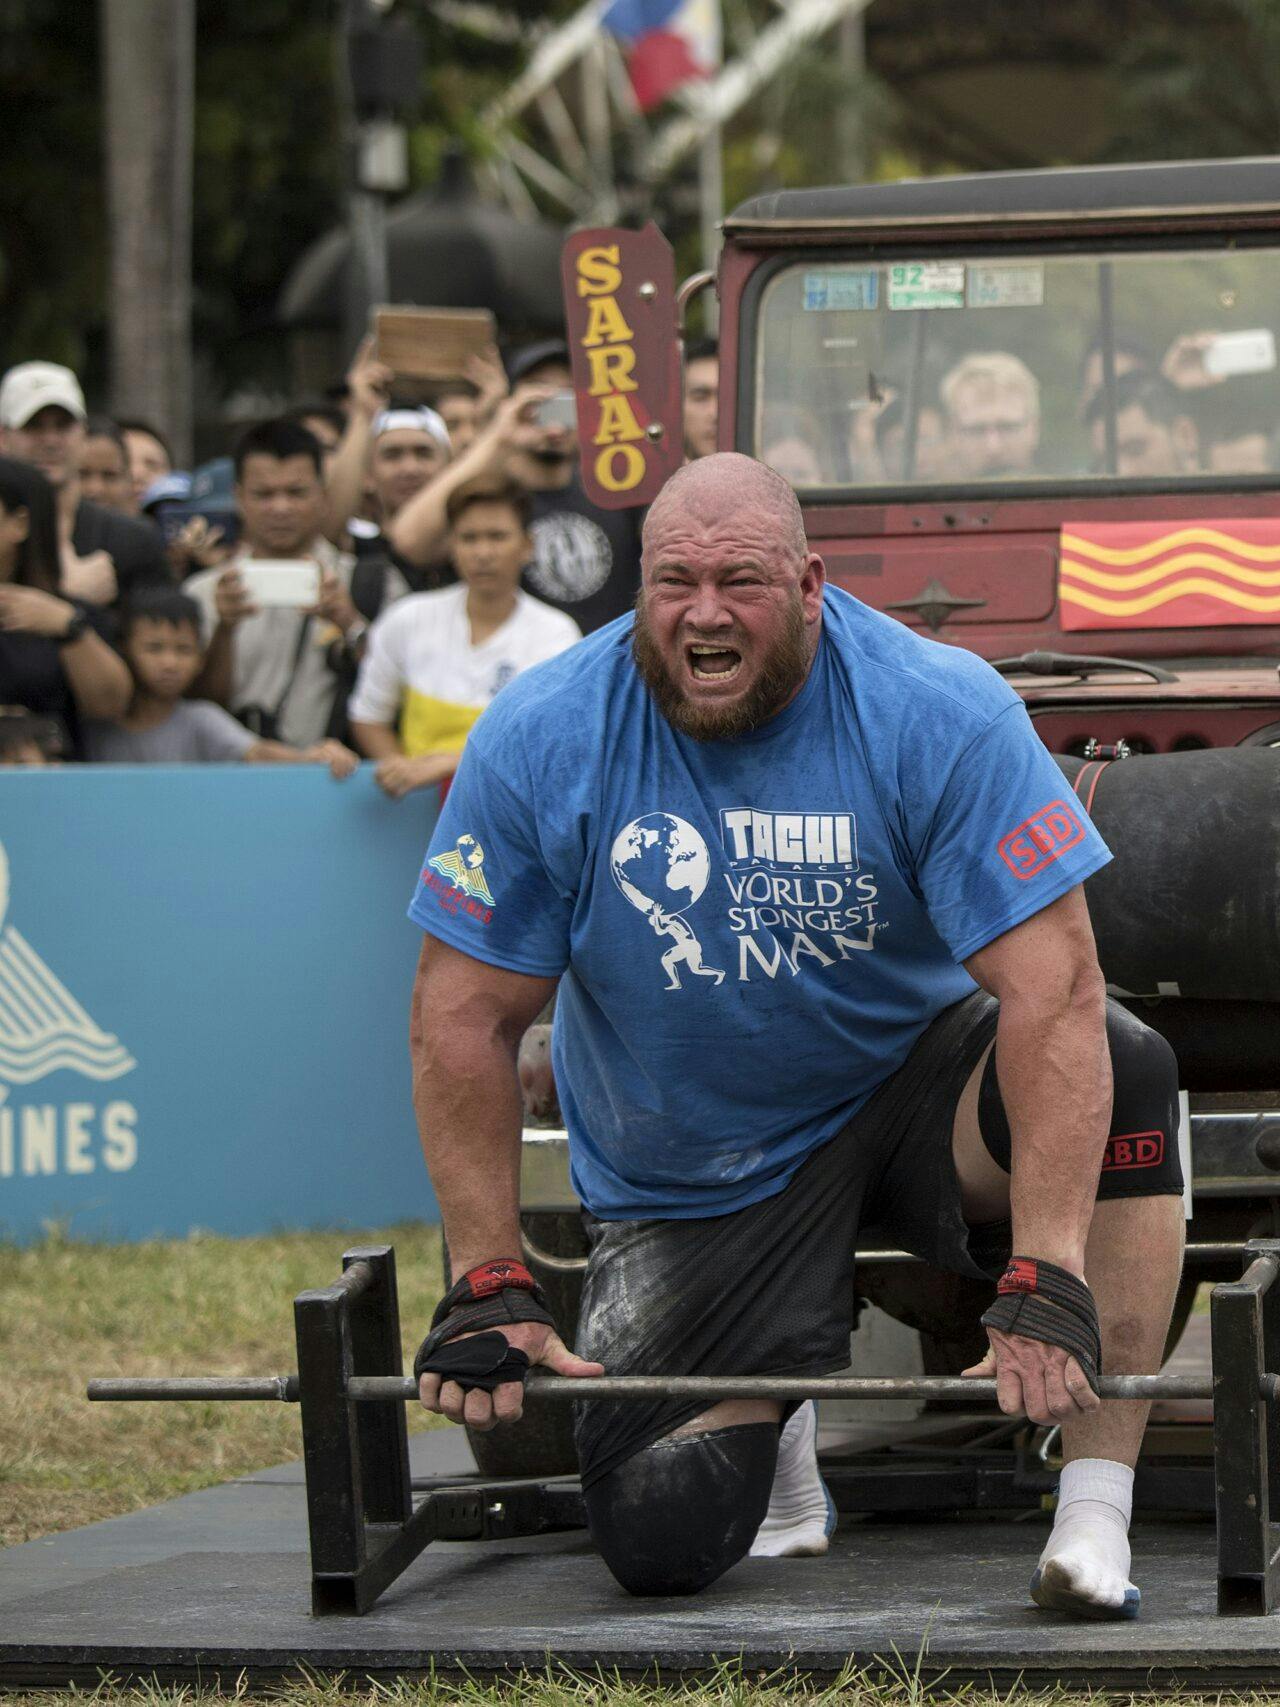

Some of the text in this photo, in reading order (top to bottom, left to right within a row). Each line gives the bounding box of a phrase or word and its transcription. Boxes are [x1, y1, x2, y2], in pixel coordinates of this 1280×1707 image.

[576, 244, 646, 492] SARAO
[724, 810, 852, 864] TACHI
[729, 858, 853, 871] PALACE
[1010, 812, 1072, 869] SBD
[728, 902, 879, 932] STONGEST
[737, 922, 877, 981] MAN
